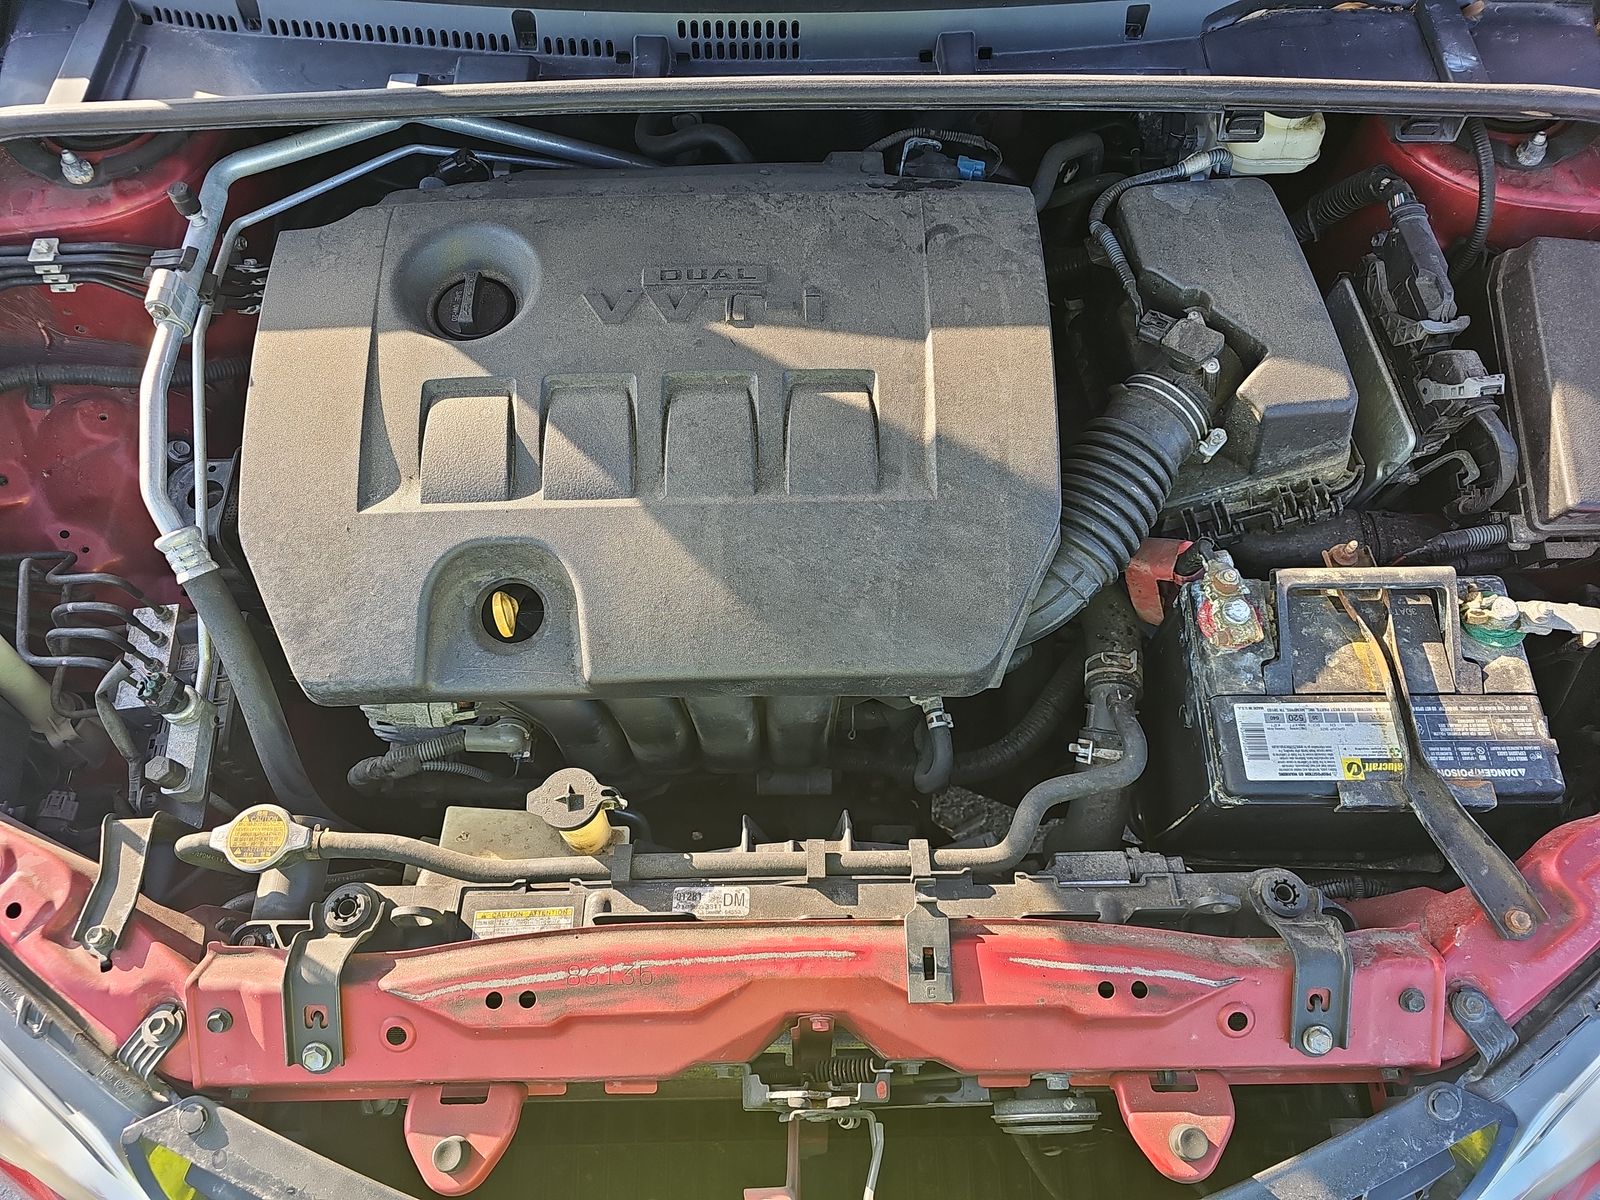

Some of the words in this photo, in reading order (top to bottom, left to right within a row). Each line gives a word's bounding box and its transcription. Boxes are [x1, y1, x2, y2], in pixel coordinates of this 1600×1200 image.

[659, 268, 757, 281] DUAL
[581, 286, 825, 327] VVT-i
[1288, 714, 1304, 722] 520
[1364, 762, 1404, 772] alucraft
[724, 893, 745, 906] DM
[528, 908, 569, 916] ATTENTION
[567, 964, 653, 986] 86135
